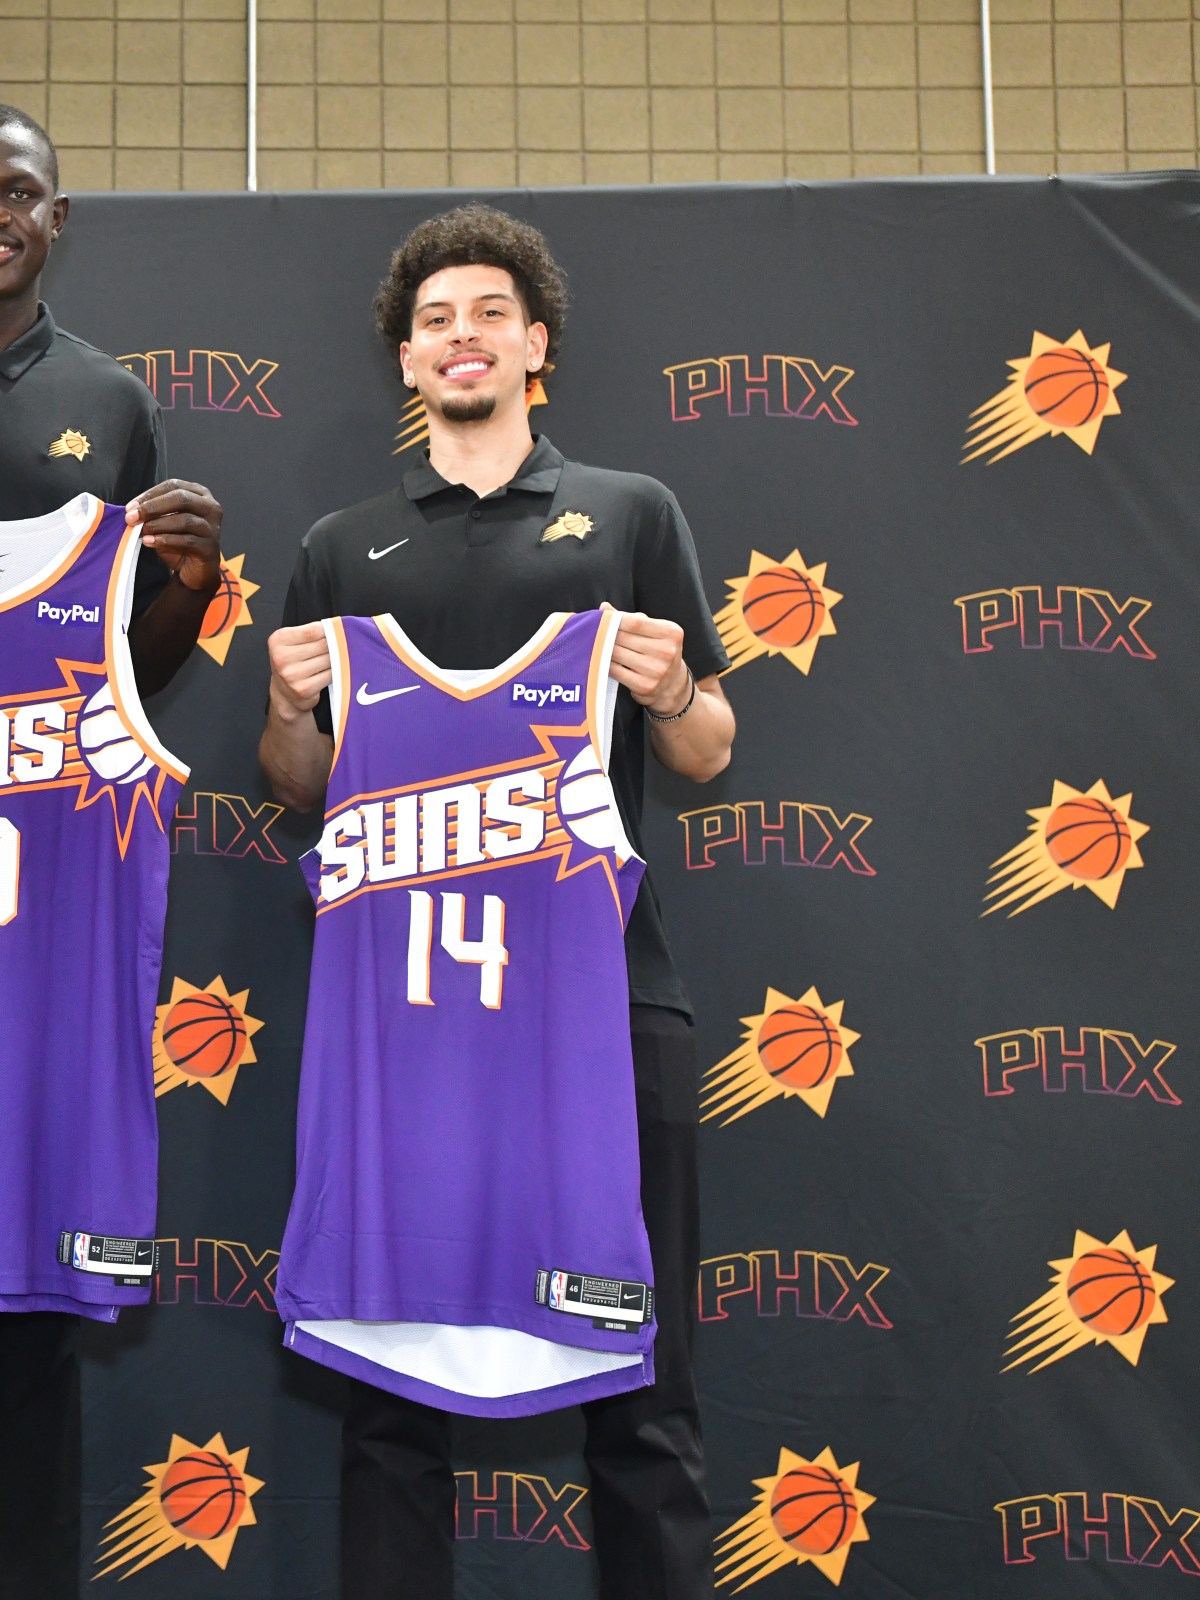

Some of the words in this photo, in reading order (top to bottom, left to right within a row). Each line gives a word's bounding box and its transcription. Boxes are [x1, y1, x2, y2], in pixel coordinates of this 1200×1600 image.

[662, 354, 859, 426] PHX
[37, 601, 100, 625] PayPal
[953, 585, 1158, 661] PHX
[512, 683, 581, 707] PayPal
[169, 791, 288, 864] HX
[677, 800, 878, 877] PHX
[407, 890, 509, 1010] 14
[973, 1026, 1183, 1106] PHX
[91, 1245, 101, 1254] 52
[153, 1238, 281, 1313] HX
[569, 1284, 579, 1293] 46
[698, 1250, 895, 1329] PHX
[453, 1471, 592, 1551] HX
[993, 1492, 1200, 1576] PHX
